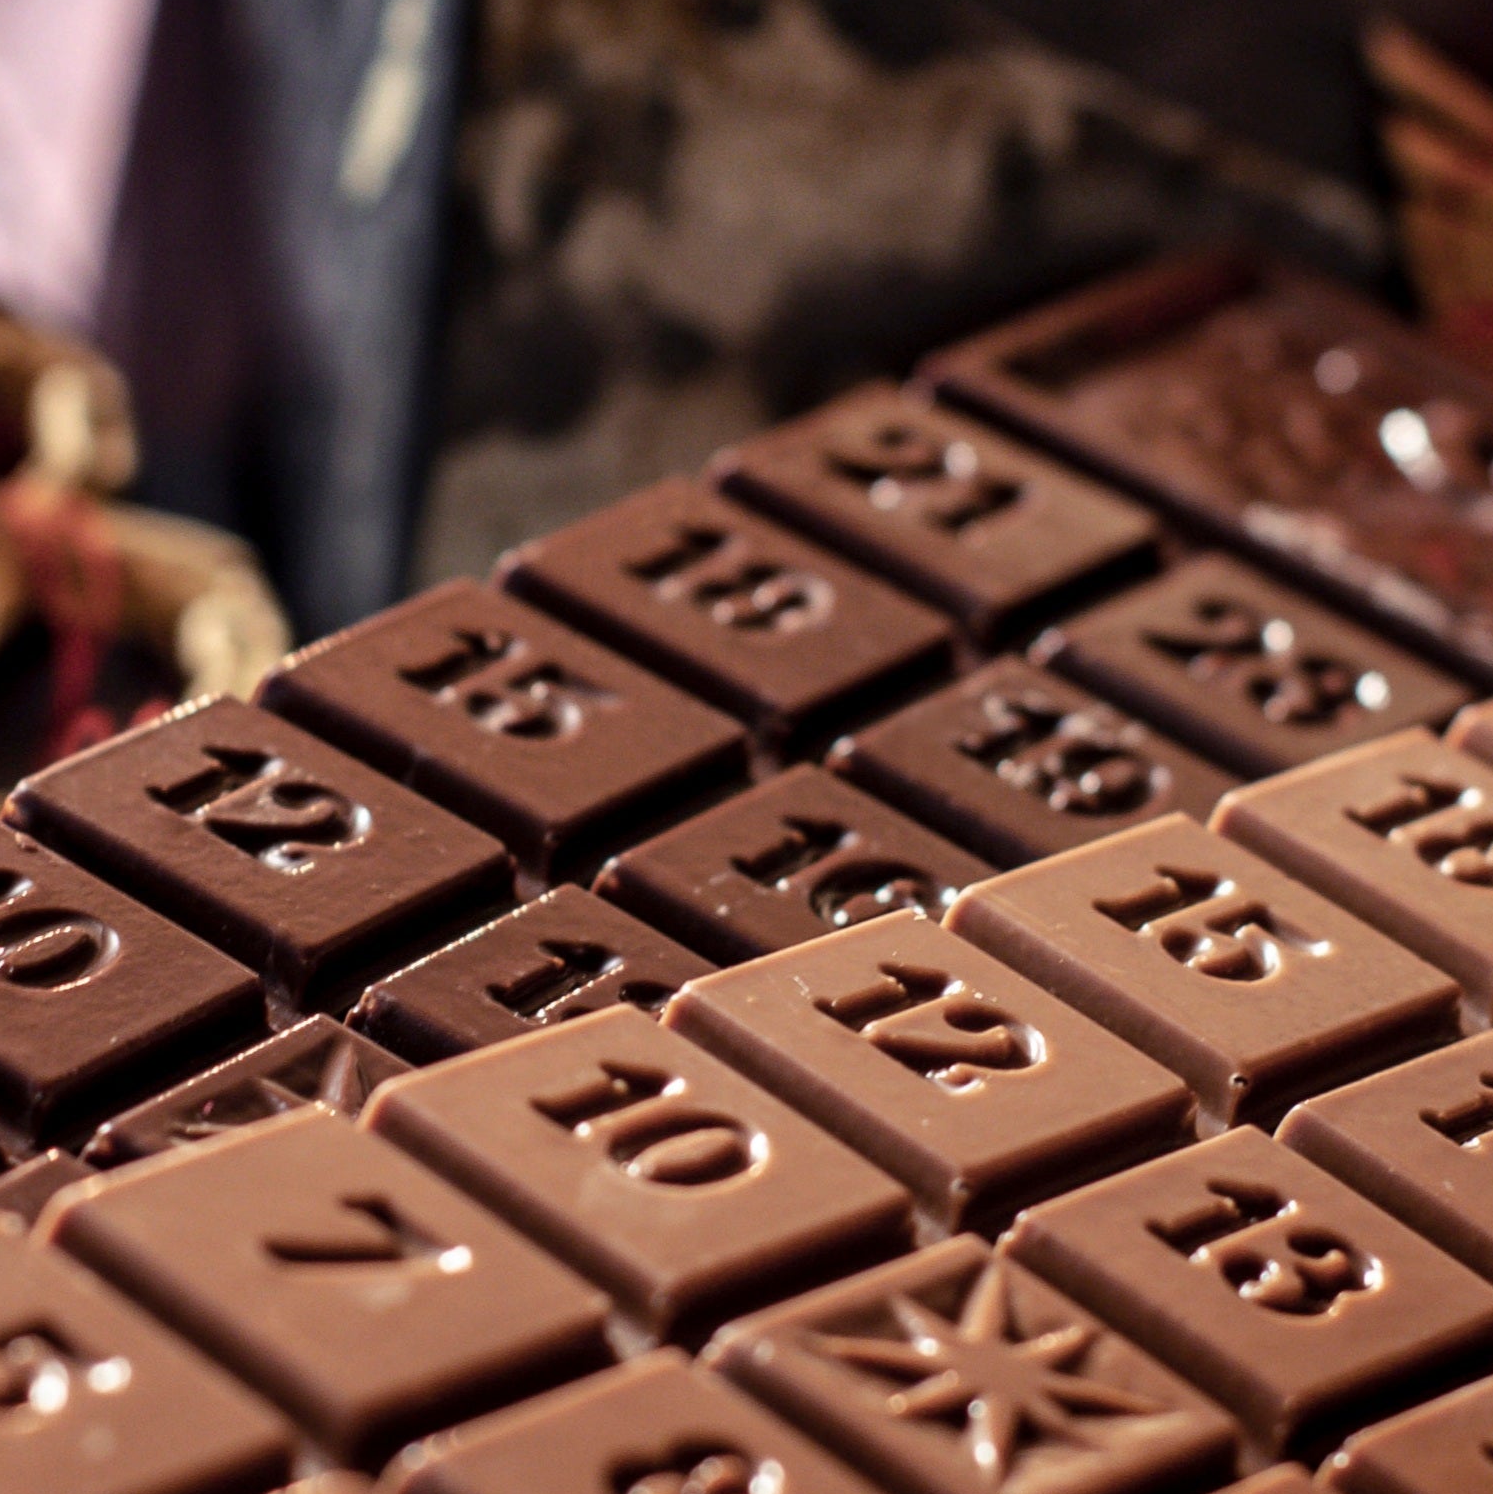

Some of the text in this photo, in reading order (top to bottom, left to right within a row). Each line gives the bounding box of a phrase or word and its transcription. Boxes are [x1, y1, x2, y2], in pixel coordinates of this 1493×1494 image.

[826, 422, 1030, 543] 21
[623, 523, 834, 634] 18
[397, 627, 610, 739] 15
[145, 744, 374, 875] 12
[1093, 864, 1332, 983] 15
[814, 961, 1046, 1095] 12
[530, 1059, 769, 1189] 10
[263, 1192, 475, 1280] 7
[1145, 1177, 1384, 1317] 13
